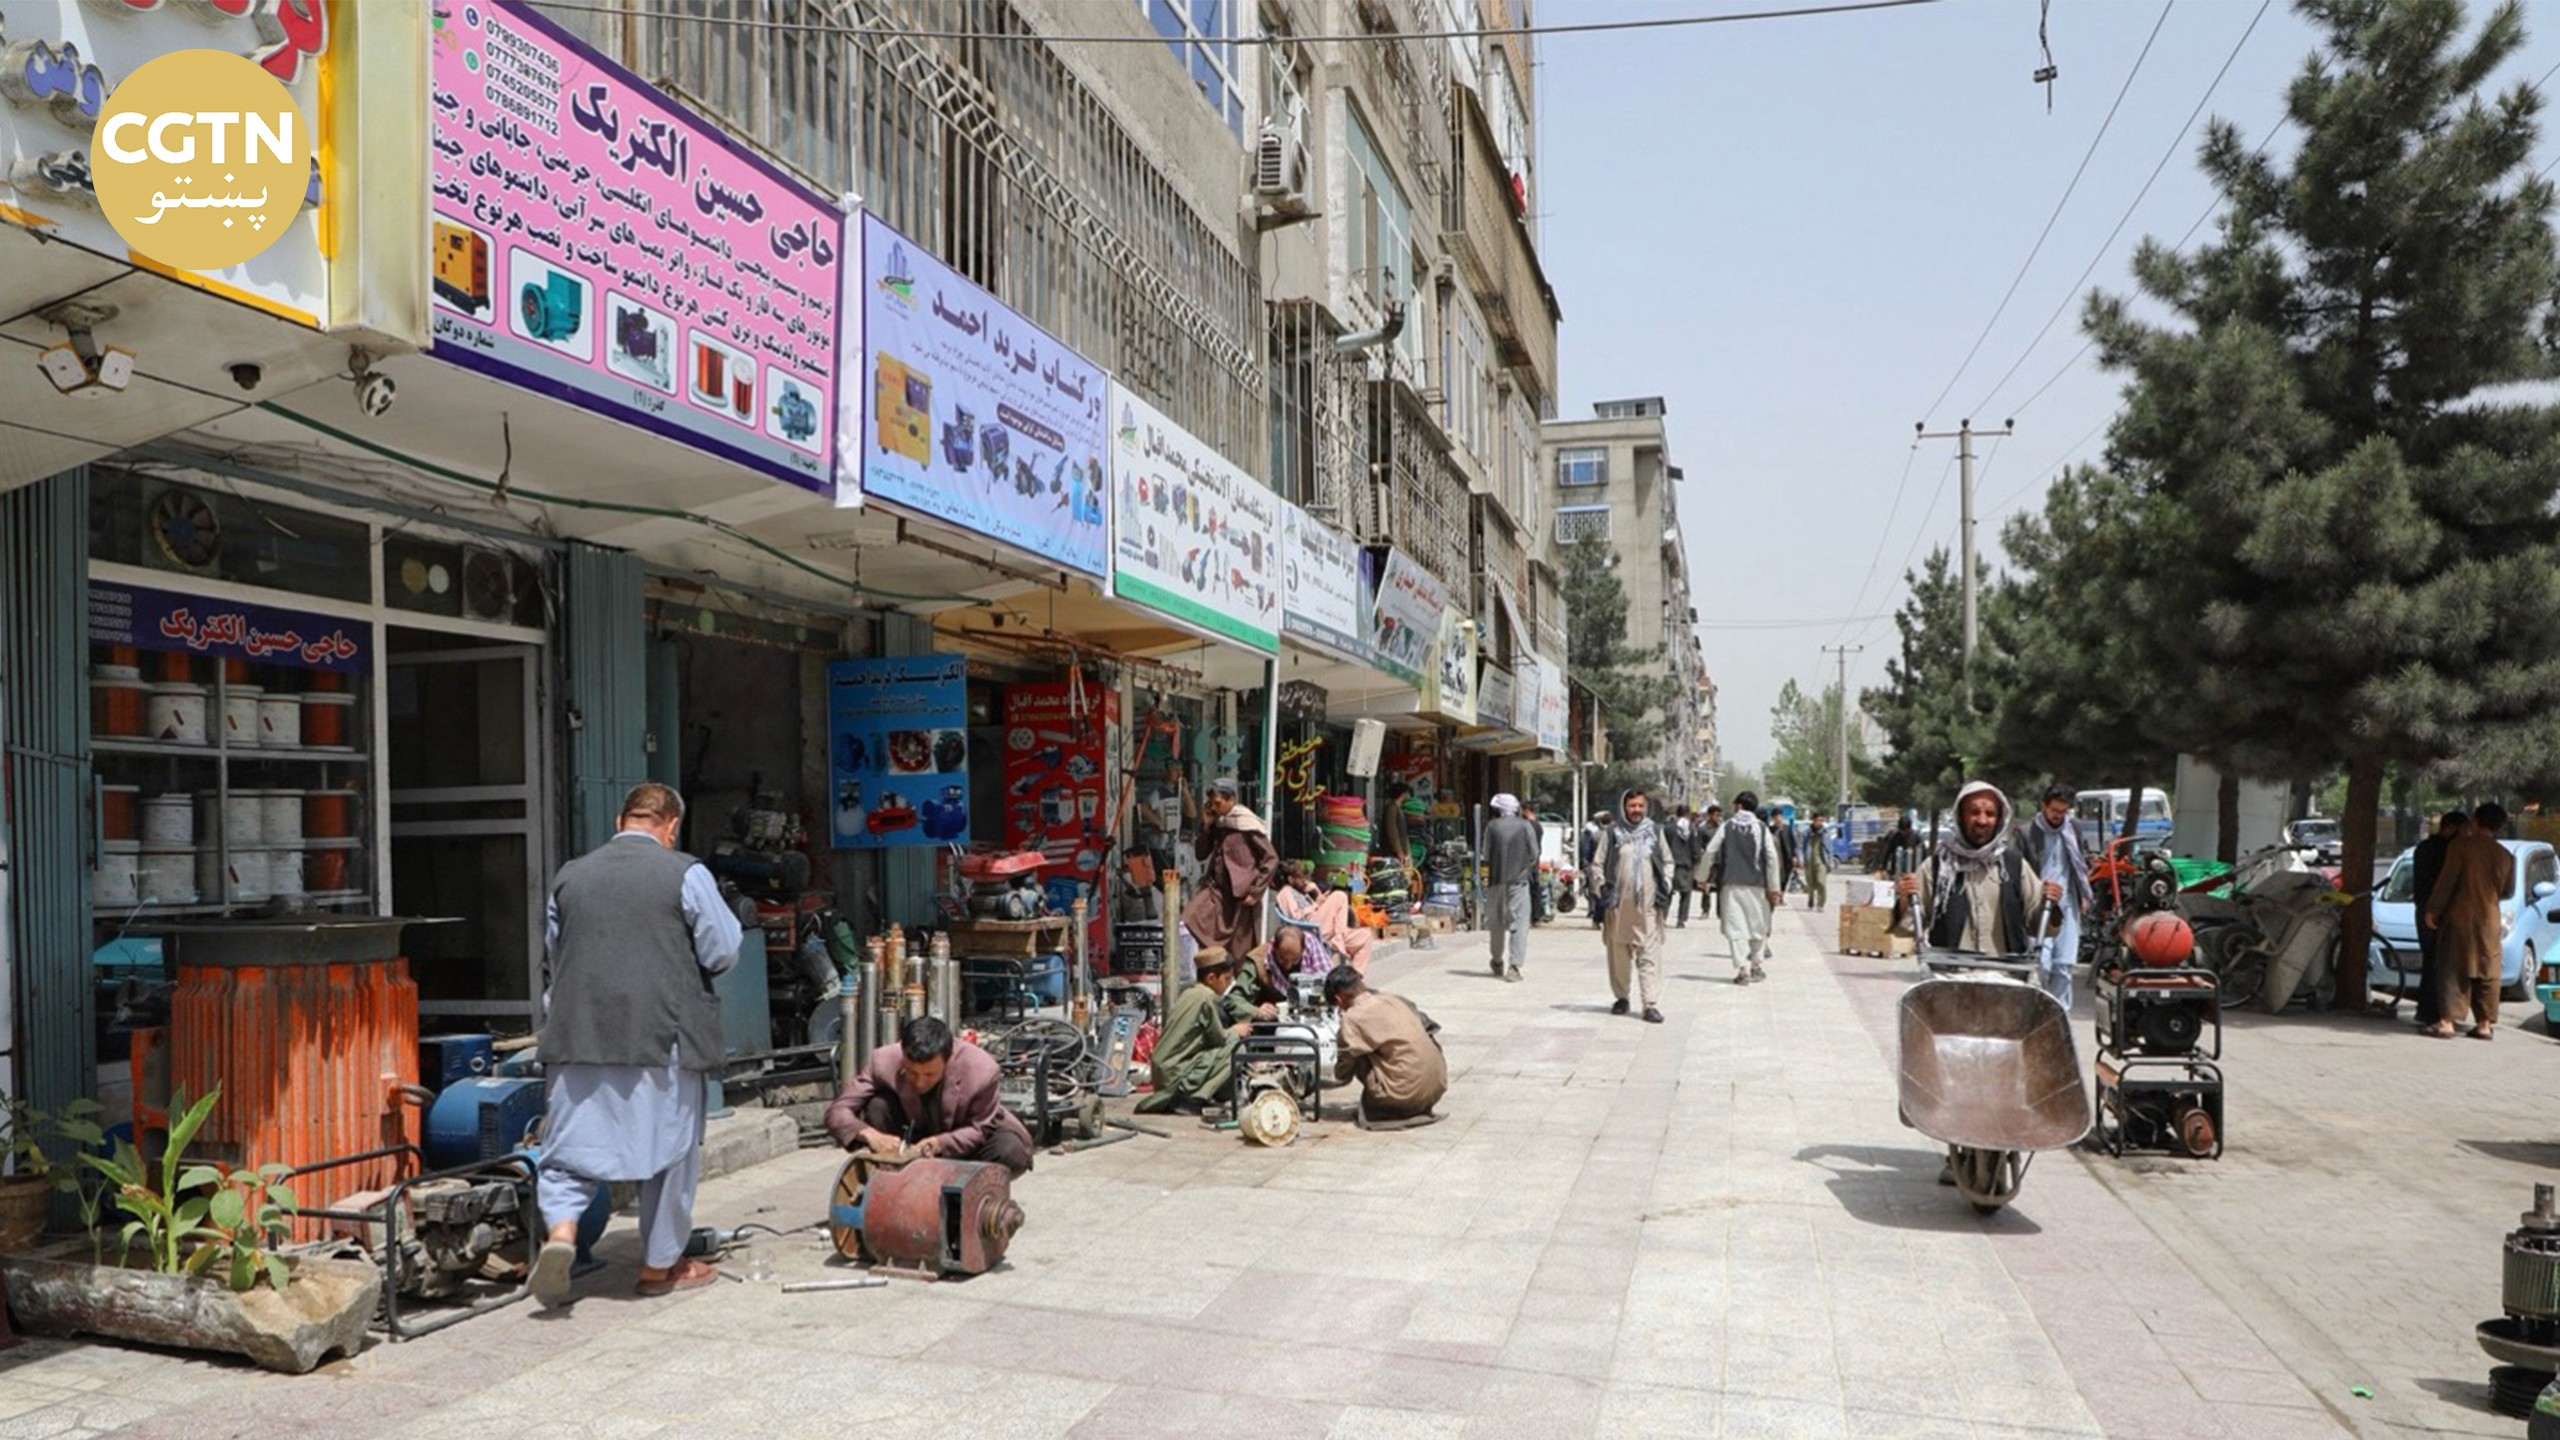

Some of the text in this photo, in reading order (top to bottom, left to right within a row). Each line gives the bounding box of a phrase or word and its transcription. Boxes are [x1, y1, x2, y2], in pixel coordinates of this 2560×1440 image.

[464, 108, 475, 130] و
[478, 113, 532, 156] جاپانی
[571, 85, 834, 268] حاجی حسین الکتریک
[526, 224, 561, 248] نصب
[564, 241, 574, 262] و
[576, 244, 618, 275] ساخت
[931, 289, 988, 344] احمد
[465, 330, 495, 349] شماره
[993, 327, 1038, 376] فرید
[1041, 357, 1102, 423] ورکشاپ
[160, 607, 247, 651] الکتریک
[245, 626, 302, 656] حسین
[301, 629, 357, 665] حاجی
